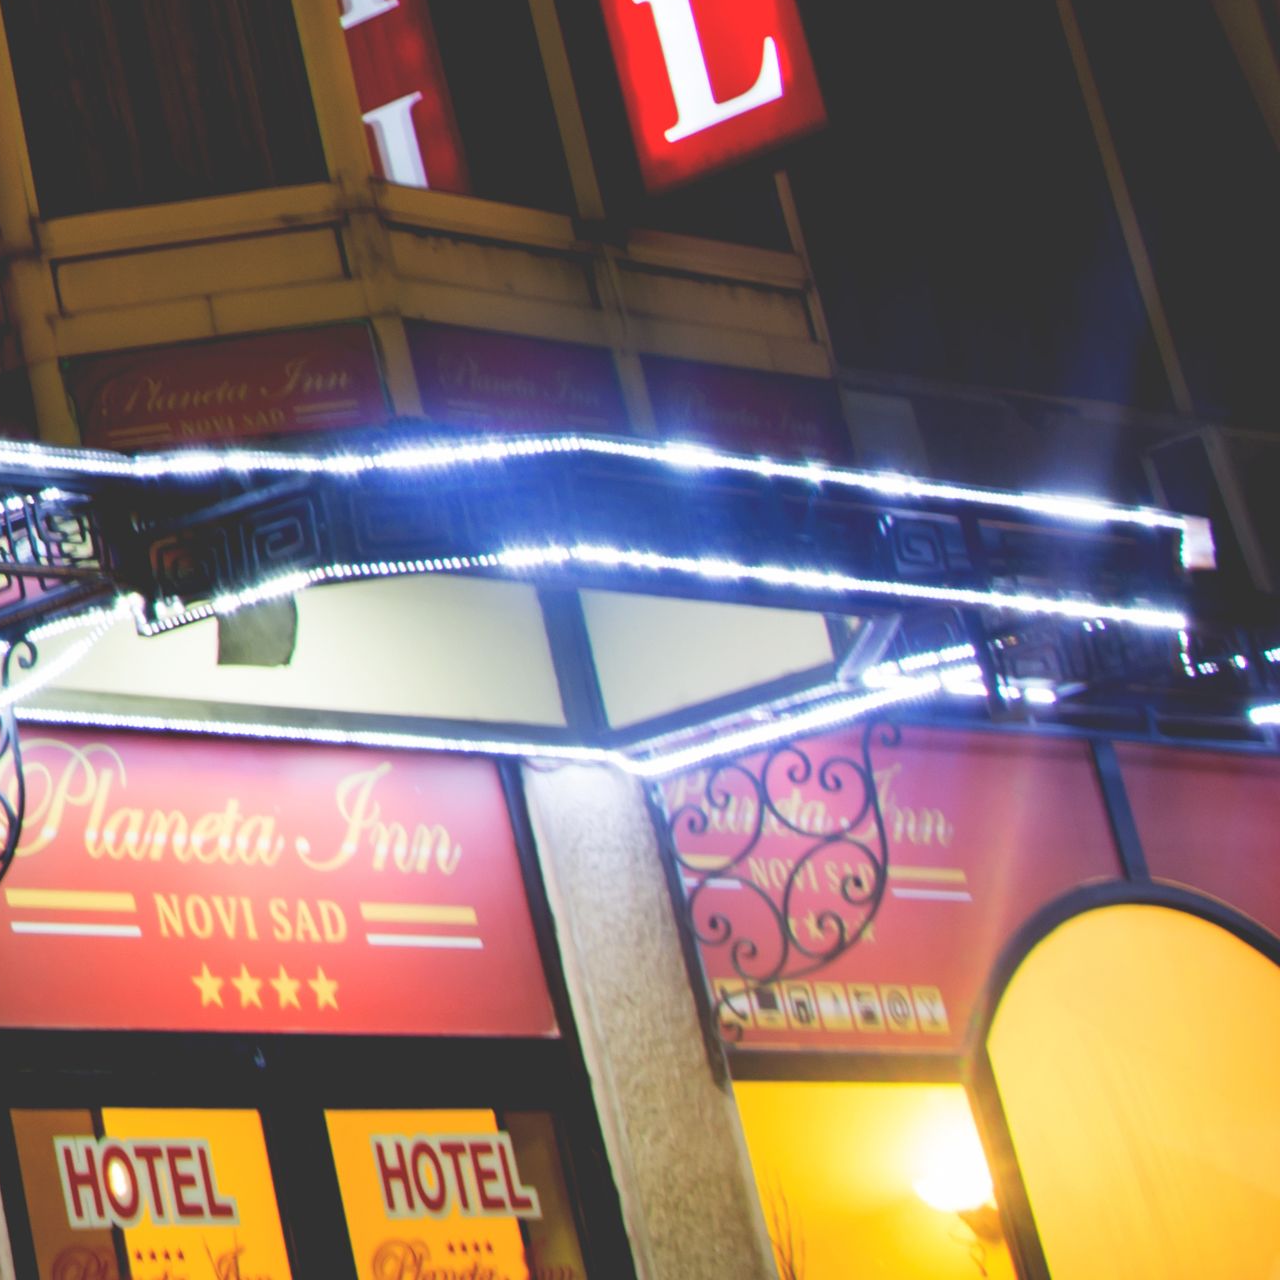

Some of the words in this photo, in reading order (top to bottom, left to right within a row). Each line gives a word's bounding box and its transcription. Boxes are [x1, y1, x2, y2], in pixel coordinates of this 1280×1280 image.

[258, 358, 349, 410] Inn
[296, 761, 462, 875] Inn
[747, 856, 820, 894] NOVI
[153, 892, 260, 941] NOVI
[268, 897, 348, 943] SAD
[62, 1144, 234, 1219] HOTEL
[374, 1140, 533, 1212] HOTEL
